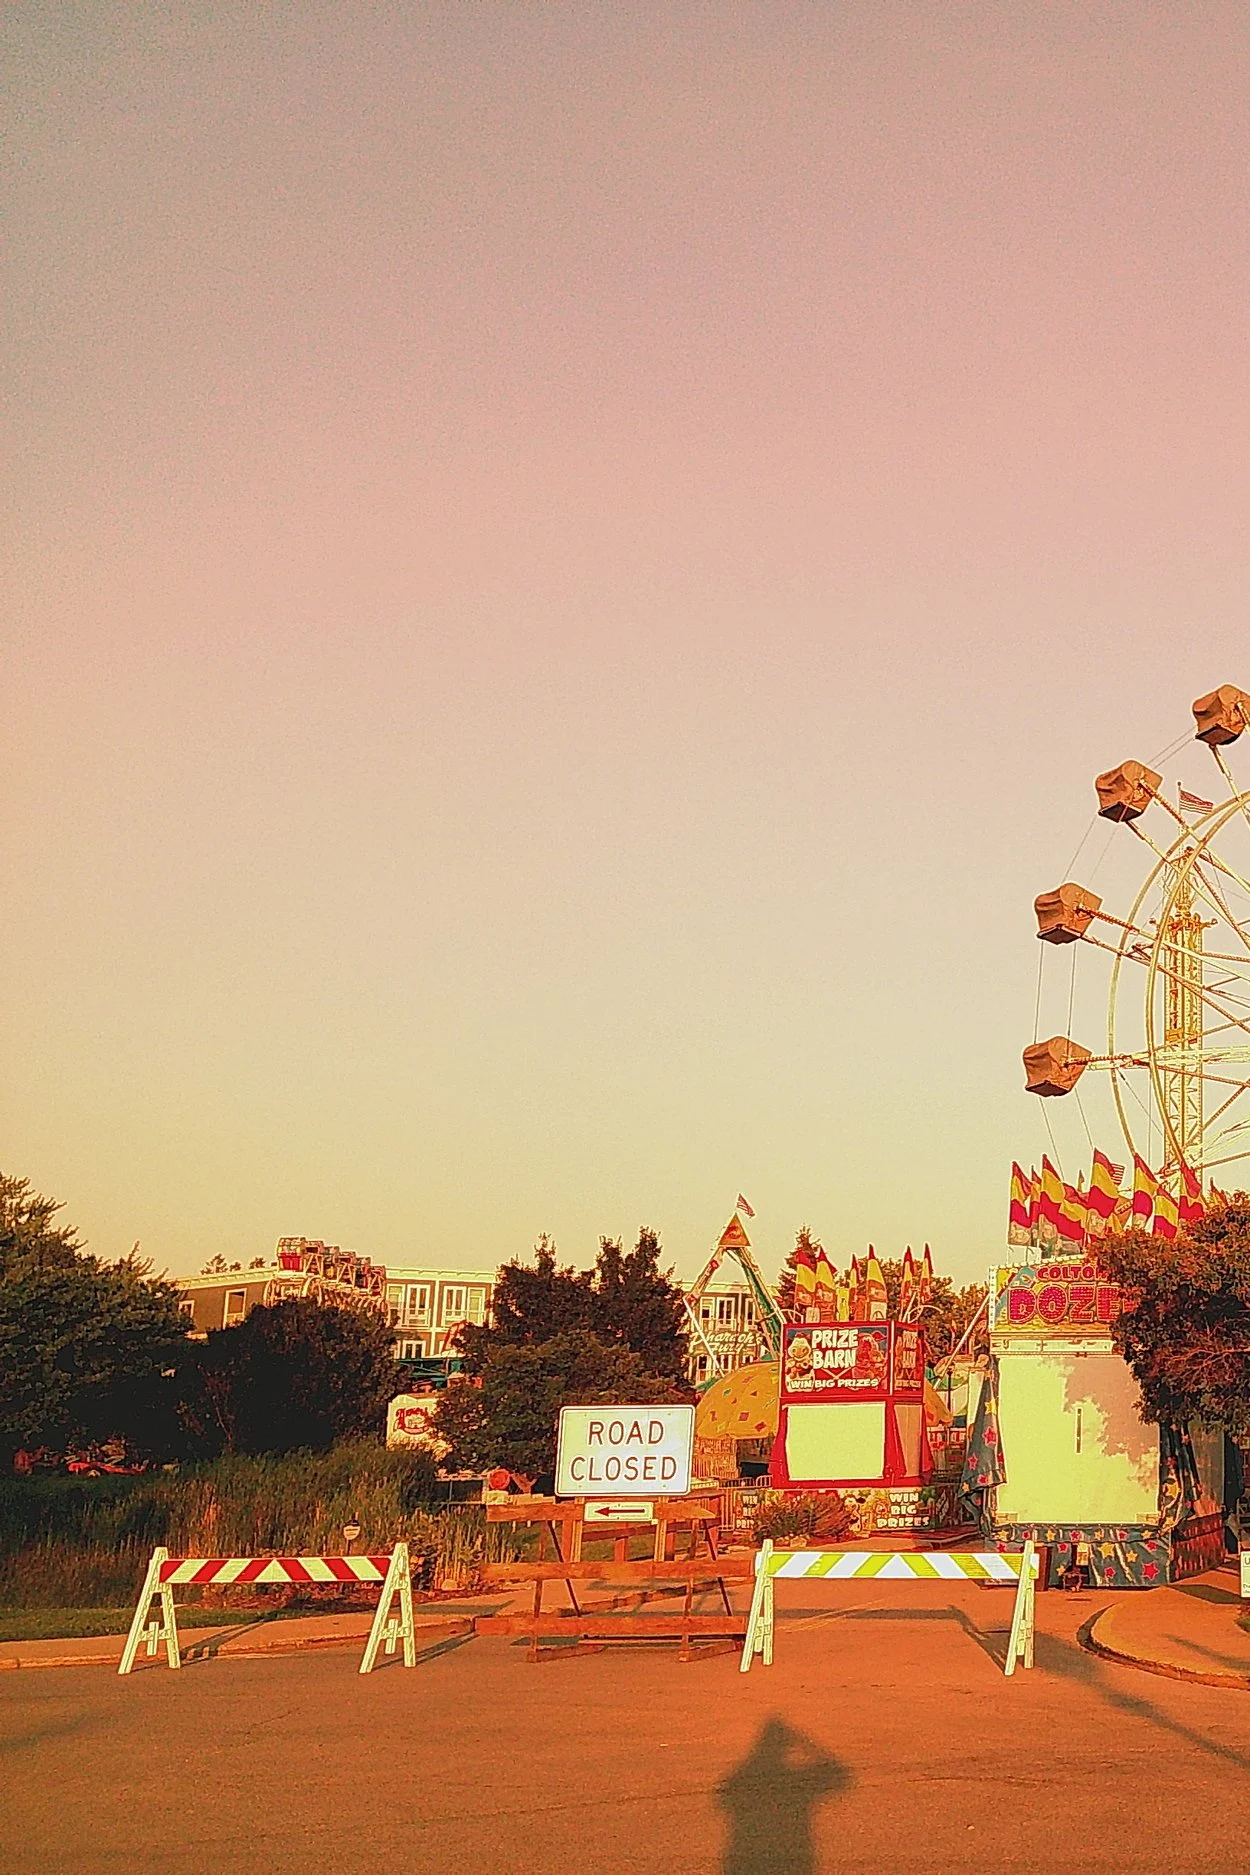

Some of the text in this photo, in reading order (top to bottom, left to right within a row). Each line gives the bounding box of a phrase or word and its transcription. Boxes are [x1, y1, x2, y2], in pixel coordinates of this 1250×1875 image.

[1007, 1284, 1136, 1324] DOZE
[811, 1329, 859, 1349] PRIZE
[812, 1349, 858, 1369] BARN
[790, 1377, 880, 1390] WIN BIG PRIZES
[588, 1420, 665, 1446] ROAD
[570, 1456, 678, 1482] CLOSED
[889, 1492, 919, 1503] WIN
[890, 1504, 917, 1515] BIG
[876, 1516, 930, 1528] PRIZES
